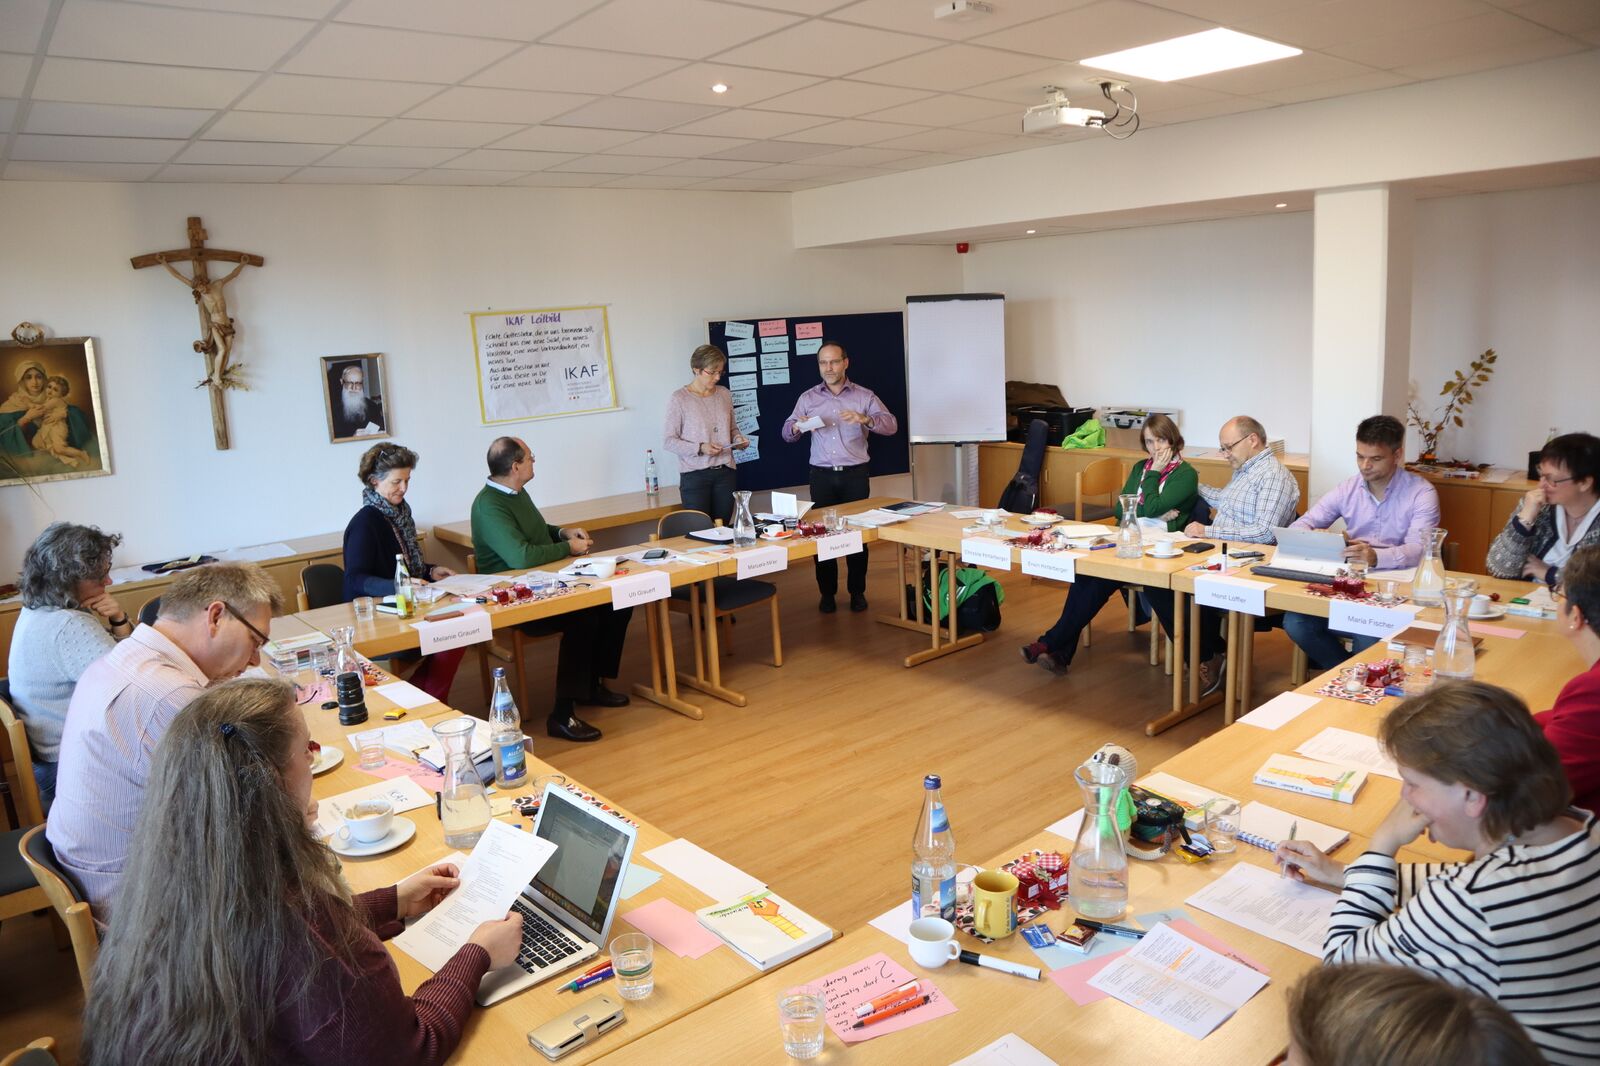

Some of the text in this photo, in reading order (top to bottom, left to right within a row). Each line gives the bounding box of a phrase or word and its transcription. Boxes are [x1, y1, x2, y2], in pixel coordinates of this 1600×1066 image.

[505, 315, 525, 326] IKAF
[564, 364, 600, 380] IKAF
[1211, 592, 1227, 600] Horst
[1347, 615, 1395, 629] Maria Fischer
[433, 627, 481, 644] Melanie Grauert
